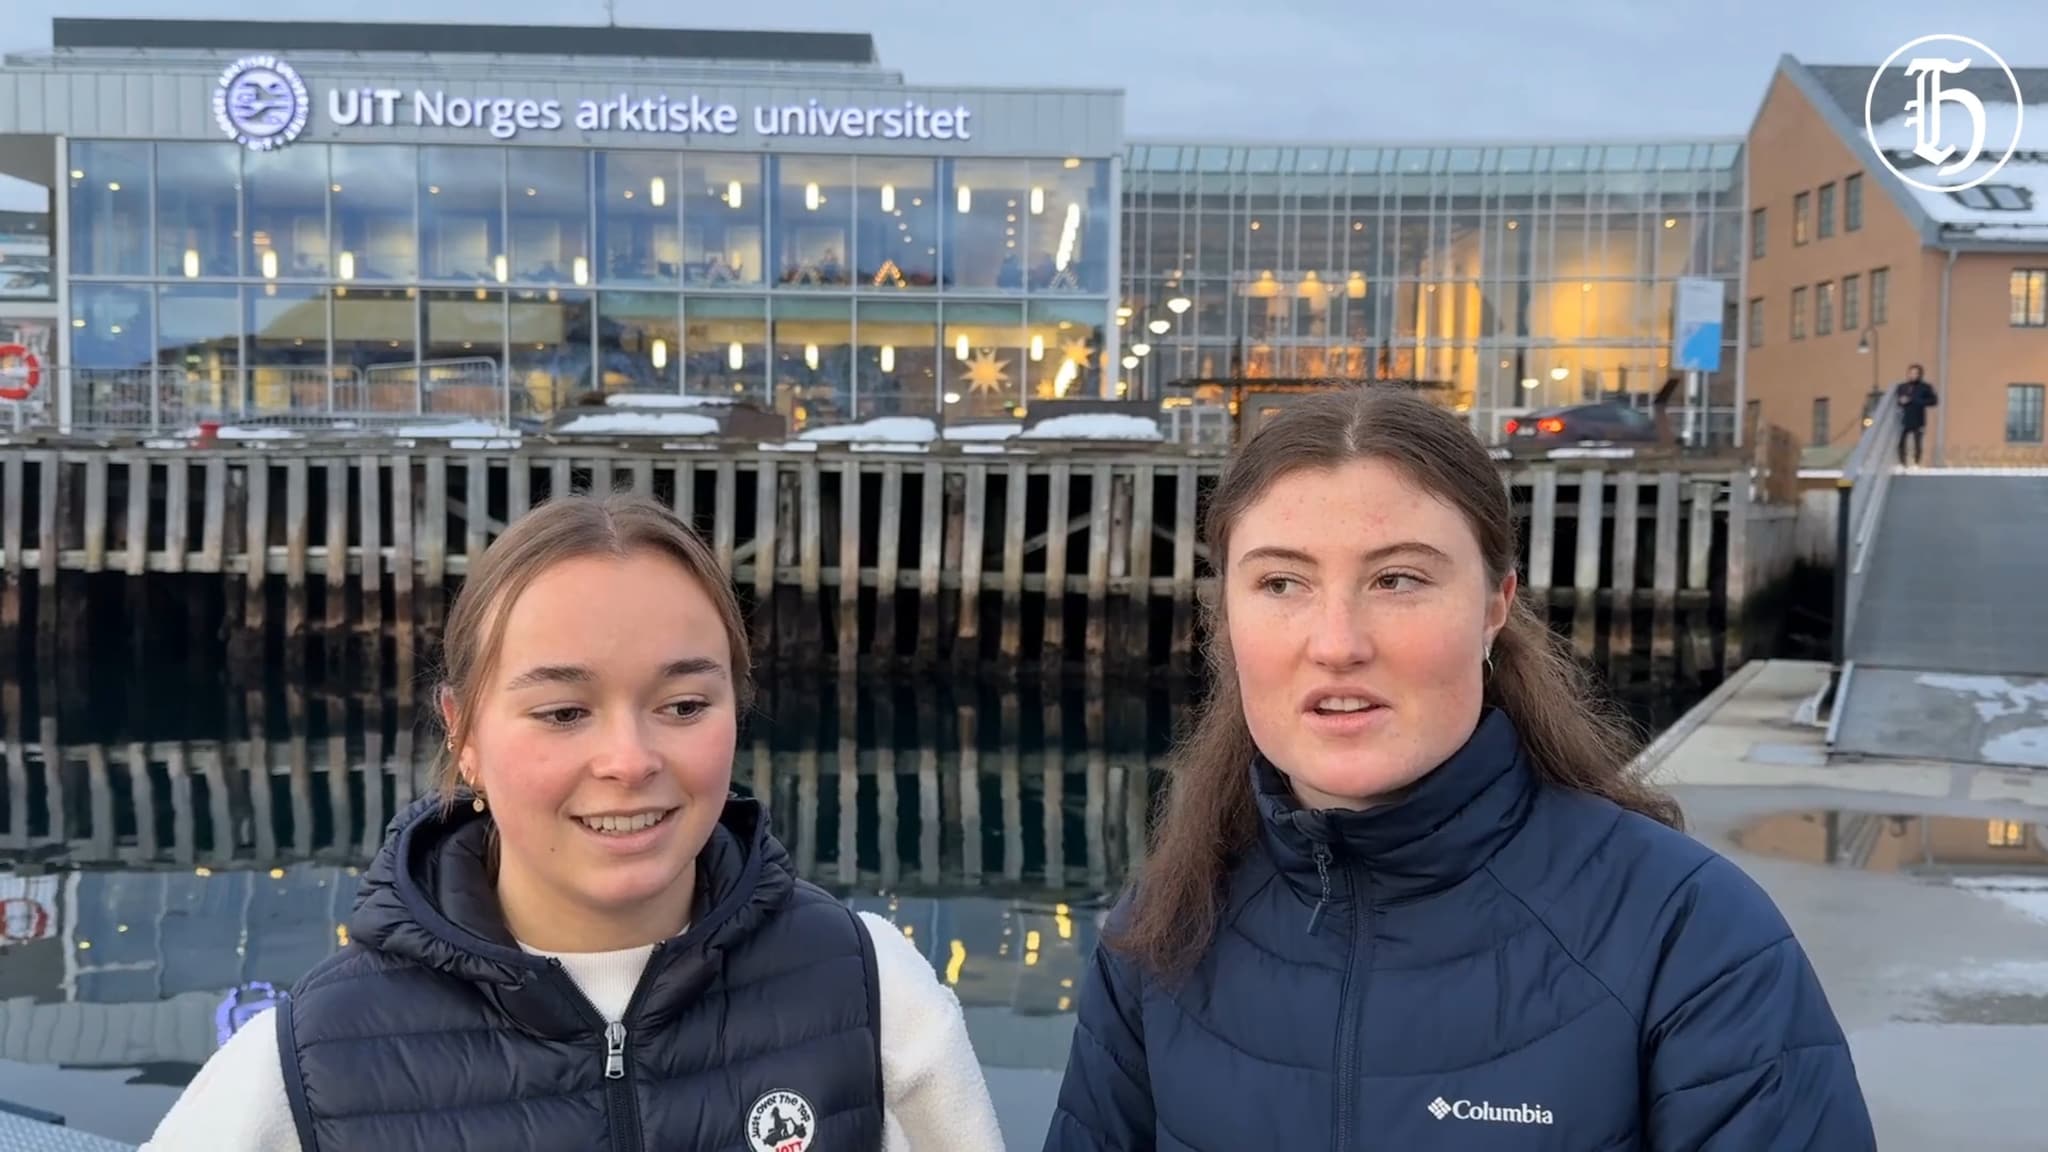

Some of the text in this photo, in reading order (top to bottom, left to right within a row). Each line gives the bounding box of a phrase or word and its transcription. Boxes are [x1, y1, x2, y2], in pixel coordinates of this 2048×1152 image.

[328, 88, 402, 126] UiT
[413, 89, 562, 138] Norges
[575, 93, 738, 134] arktiske
[753, 99, 971, 140] universitet
[1452, 1099, 1553, 1124] Columbia
